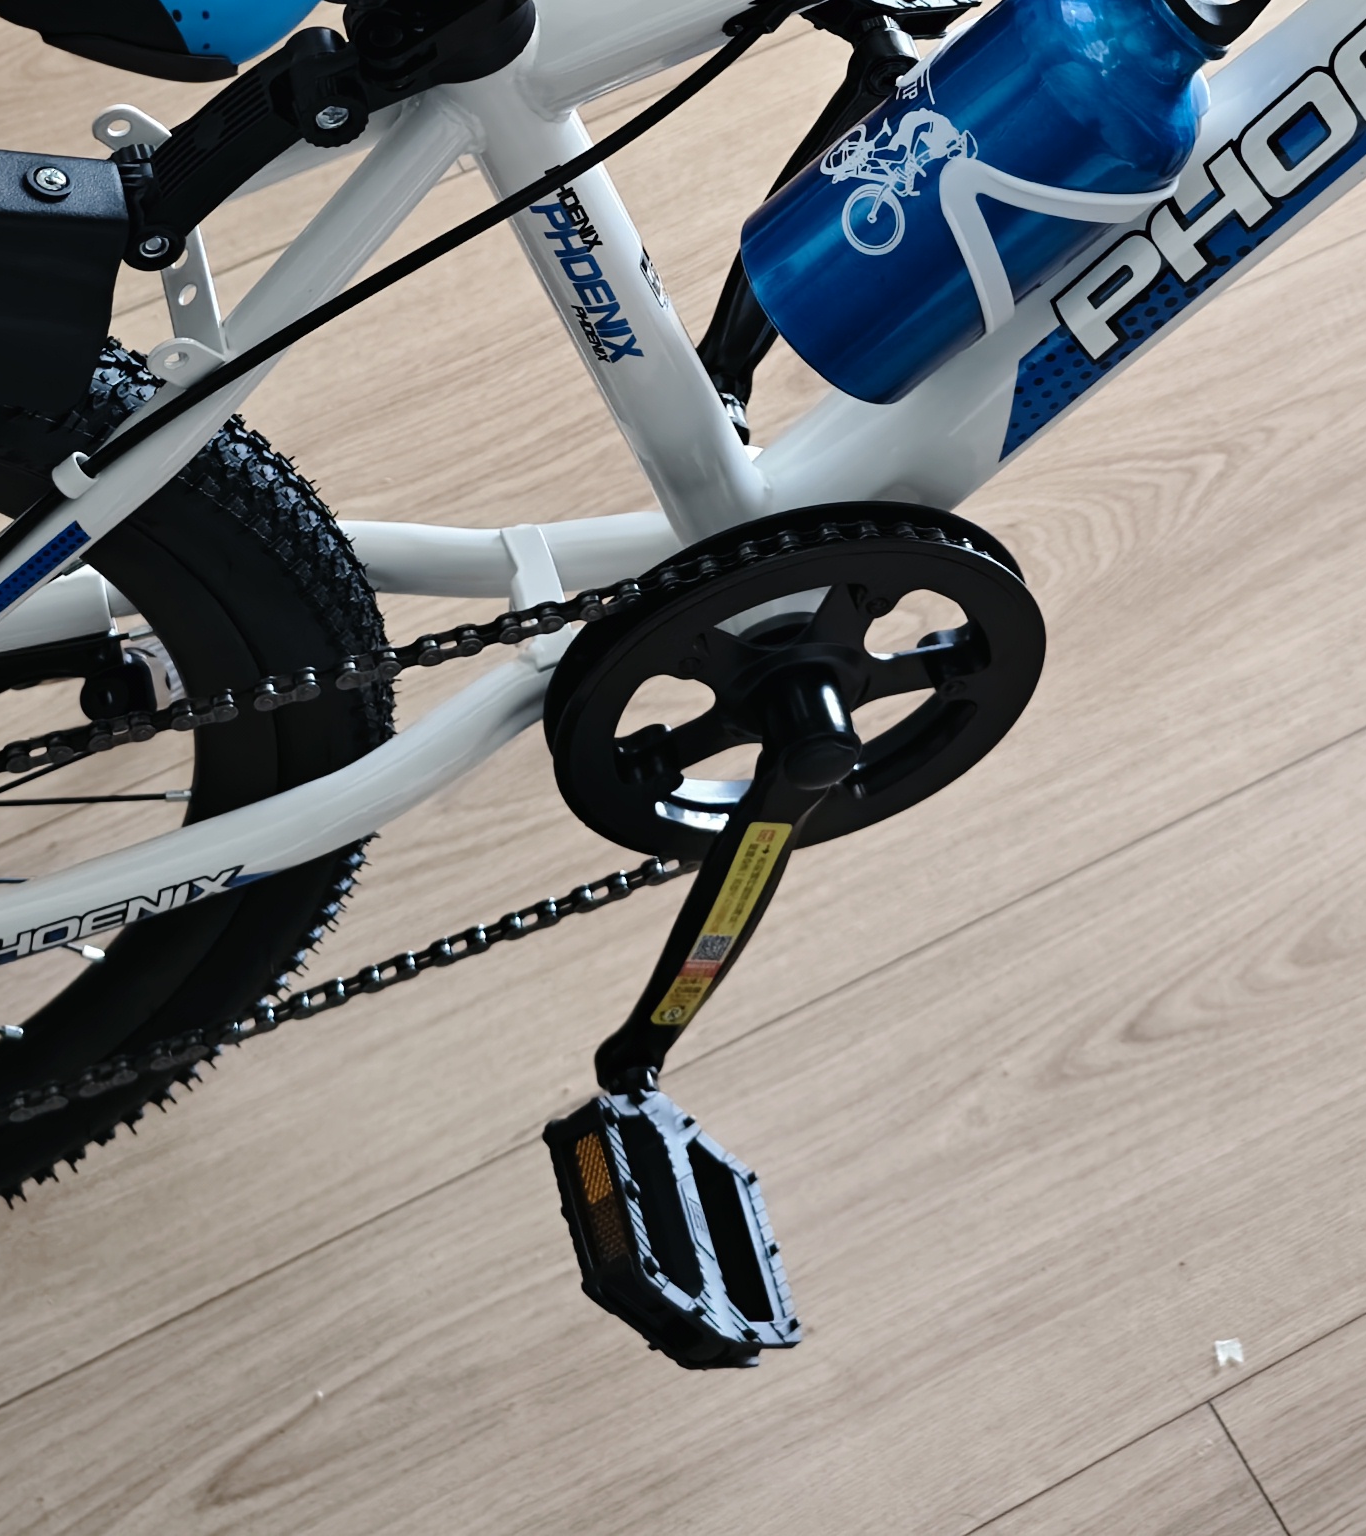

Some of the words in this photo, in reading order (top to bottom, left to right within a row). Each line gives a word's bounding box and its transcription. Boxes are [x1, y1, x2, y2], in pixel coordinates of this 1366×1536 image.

[543, 165, 603, 251] HOENIX
[530, 203, 644, 364] PHOENIX
[571, 304, 612, 365] PHOENIX
